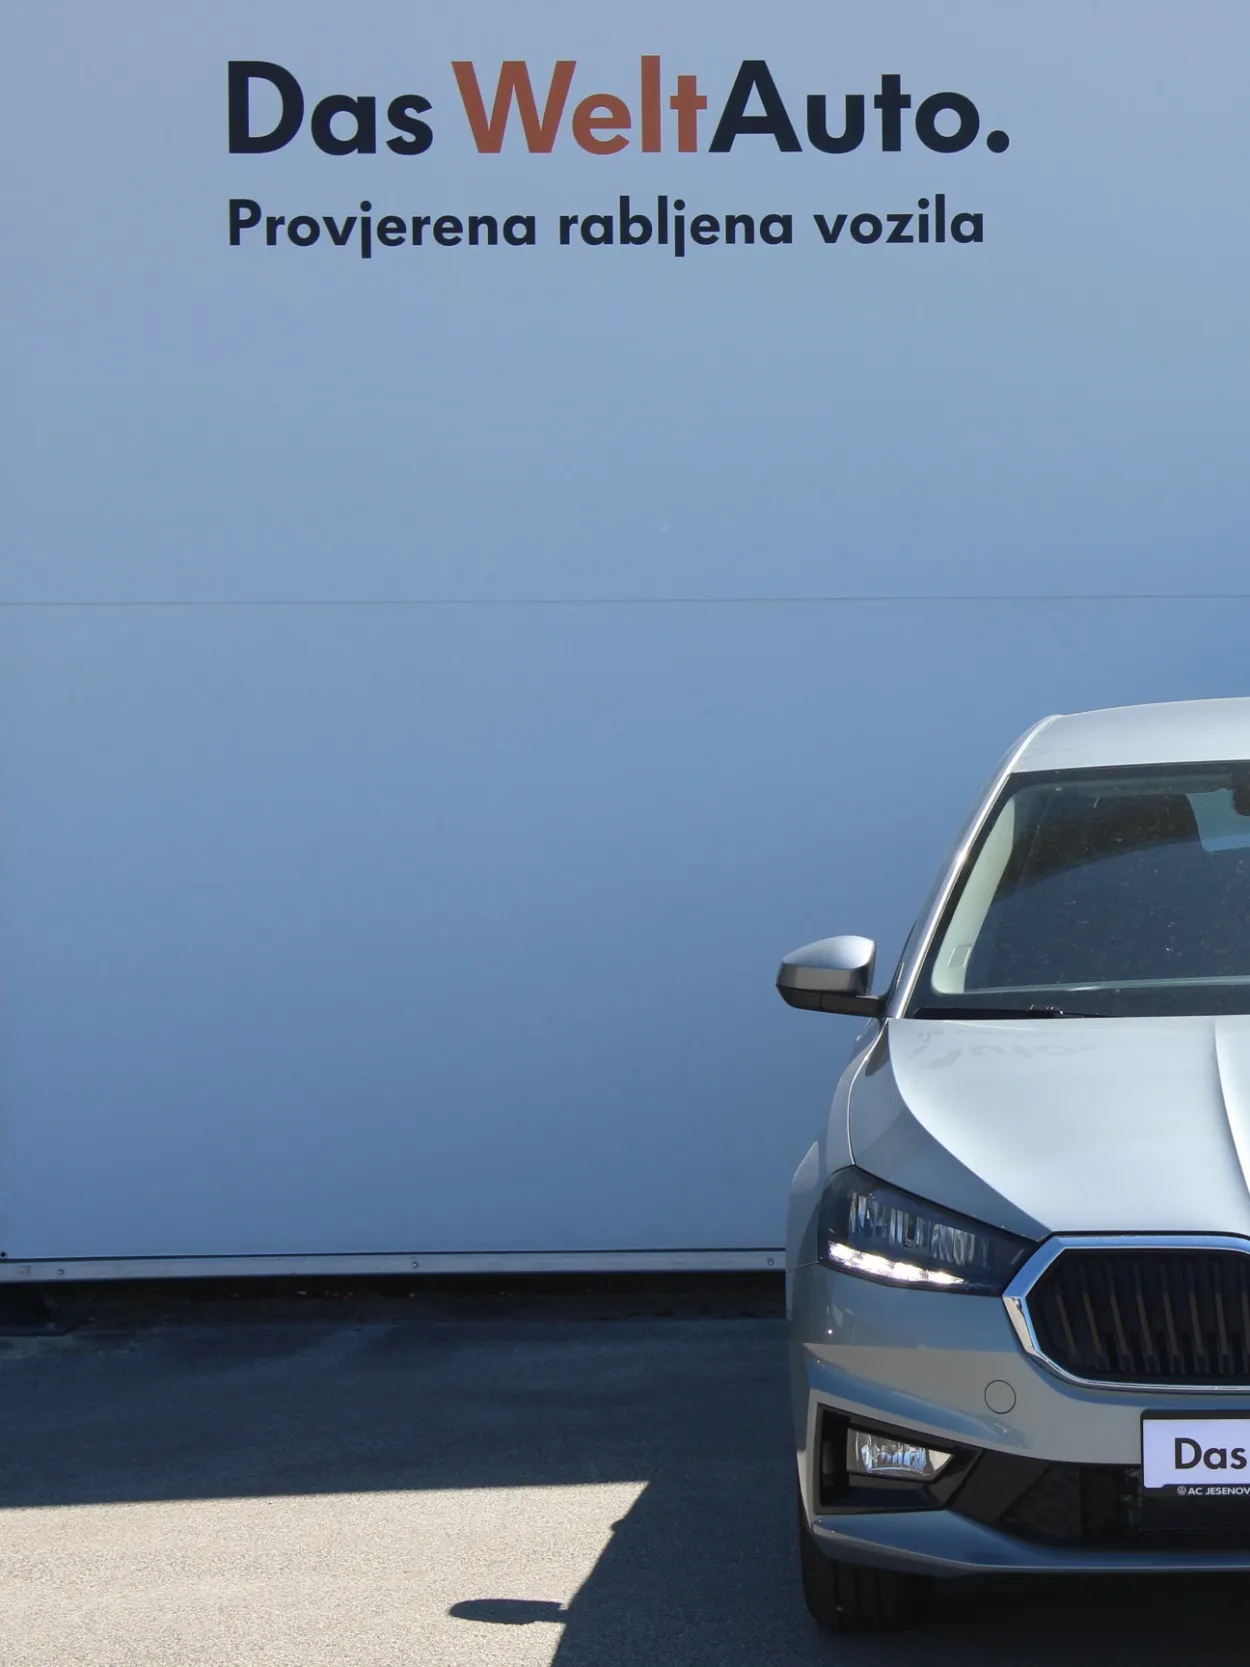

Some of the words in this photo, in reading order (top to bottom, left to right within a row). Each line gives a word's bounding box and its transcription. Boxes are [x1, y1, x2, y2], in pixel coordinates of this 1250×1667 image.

[228, 61, 433, 156] Das
[451, 55, 1010, 155] WeltAuto.
[228, 198, 536, 259] Provjerena
[559, 195, 793, 258] rabljena
[813, 193, 984, 245] vozila
[1174, 1437, 1247, 1470] Das
[1187, 1486, 1202, 1496] AC
